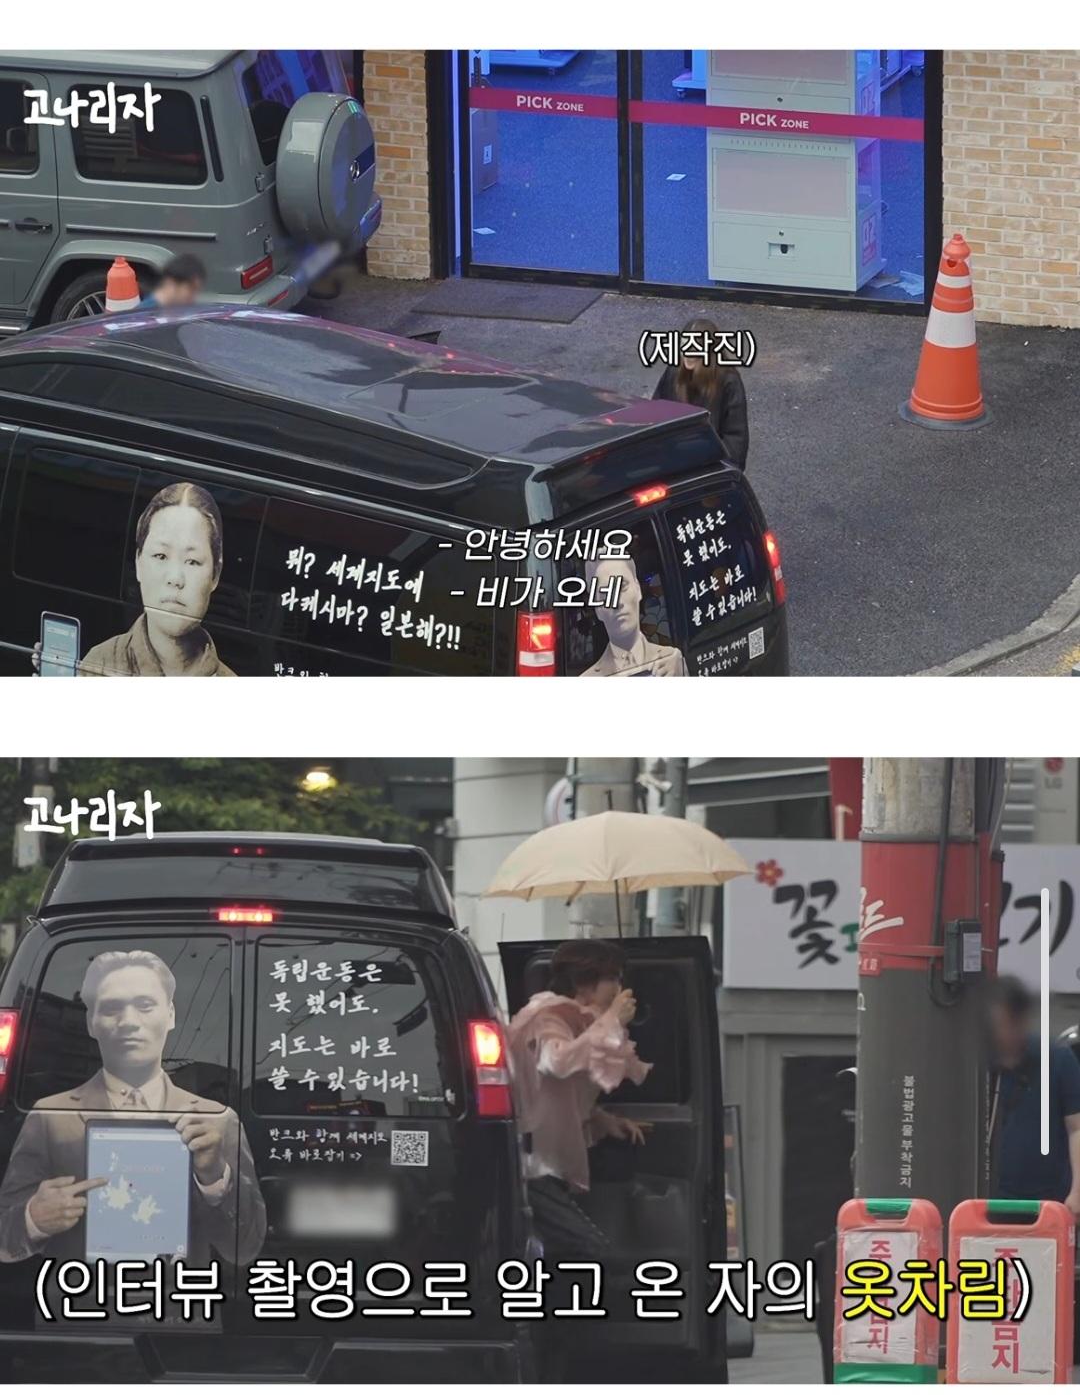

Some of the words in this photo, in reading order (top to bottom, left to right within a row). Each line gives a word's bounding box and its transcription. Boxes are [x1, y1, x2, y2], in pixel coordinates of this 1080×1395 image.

[516, 95, 553, 109] PICK
[556, 101, 585, 112] ZONE
[739, 111, 778, 128] PICK
[780, 118, 810, 130] ZONE
[689, 576, 719, 601] 지도는
[724, 564, 745, 586] 바로
[281, 586, 369, 632] 다케시마?
[379, 605, 461, 650] 일본해?!!
[269, 960, 382, 983] 독립운동은
[269, 992, 291, 1013] 못
[268, 1033, 335, 1058] 지도는
[350, 1036, 397, 1059] 바로
[268, 1066, 290, 1091] 쓸
[298, 1068, 320, 1091] 수
[327, 1066, 419, 1093] 있습니다!
